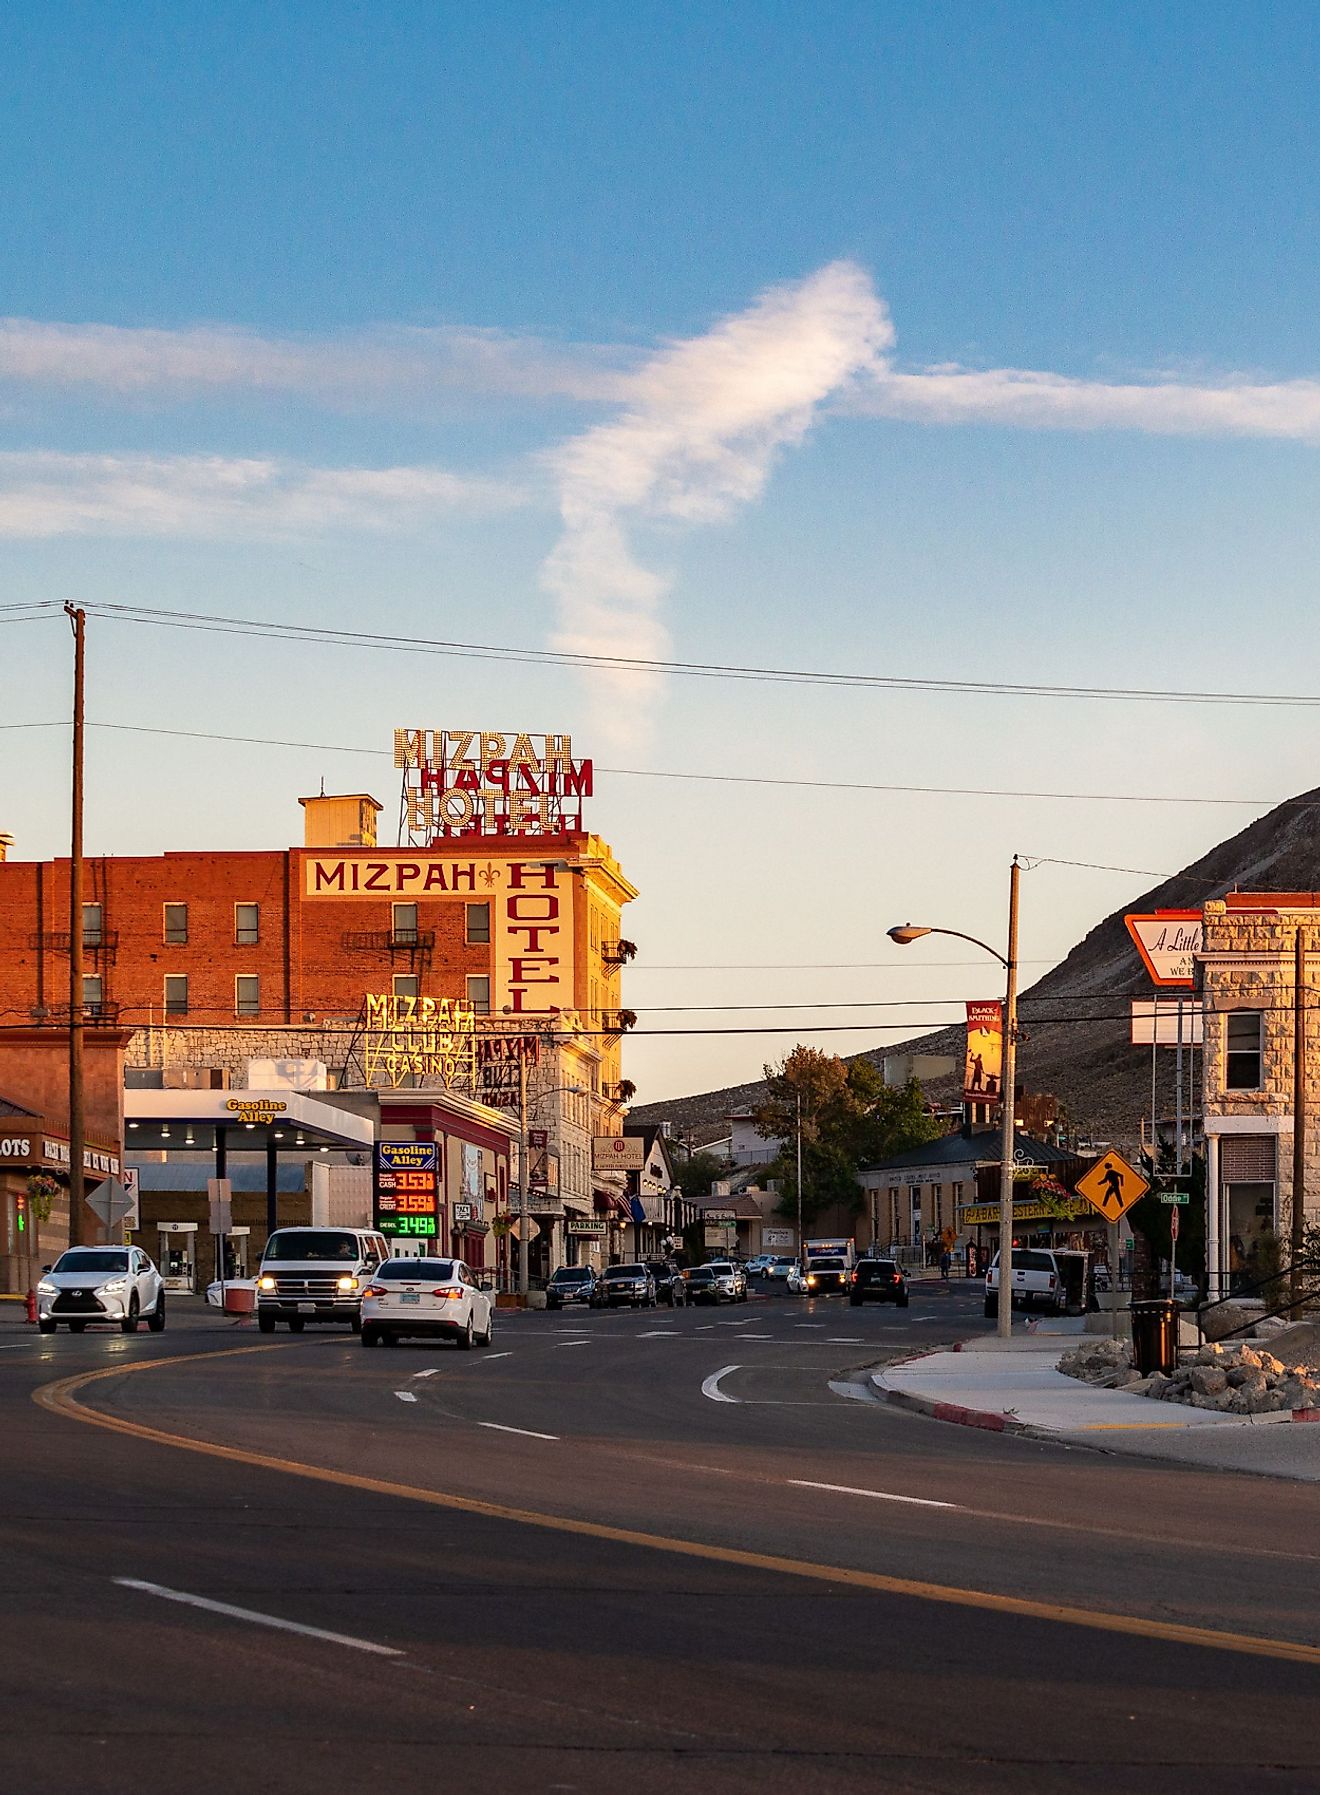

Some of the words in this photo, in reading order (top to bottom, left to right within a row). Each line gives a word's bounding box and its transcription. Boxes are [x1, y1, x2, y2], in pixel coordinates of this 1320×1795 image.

[394, 728, 571, 774] MIZPAH
[407, 787, 562, 831] HOTEL
[314, 861, 476, 892] MIZPAH
[506, 862, 560, 1014] HOTEL
[1148, 927, 1167, 952] A
[1167, 927, 1200, 952] Little
[1170, 967, 1184, 976] WE
[366, 992, 476, 1032] MIZPAH
[391, 1026, 454, 1053] CLUB
[386, 1055, 455, 1076] CASINO
[226, 1099, 287, 1111] Gasoline
[237, 1111, 275, 1124] Alley
[0, 1138, 30, 1157] OTS
[382, 1145, 433, 1155] Gasoline
[391, 1156, 423, 1166] Alley
[570, 1221, 604, 1229] PARKING
